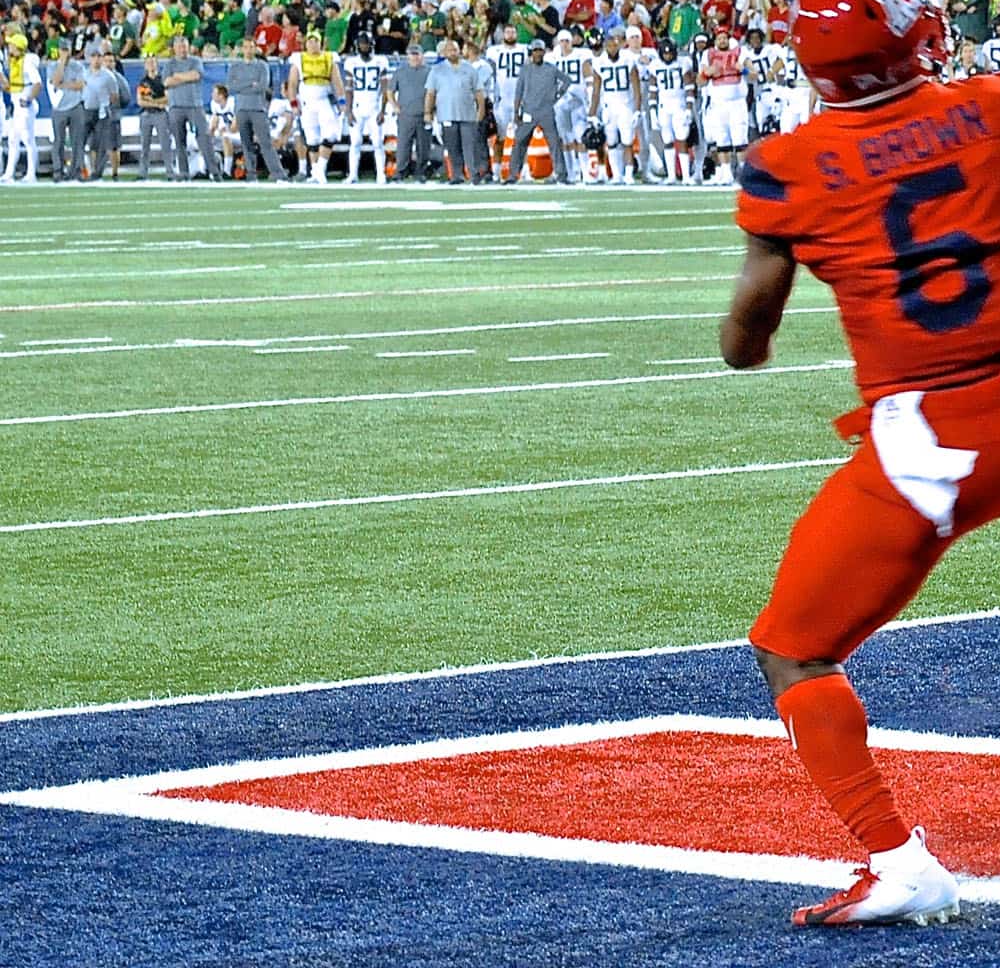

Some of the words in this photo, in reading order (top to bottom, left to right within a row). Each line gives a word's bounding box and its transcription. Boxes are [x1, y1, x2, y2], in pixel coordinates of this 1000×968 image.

[353, 66, 381, 91] 93
[498, 52, 526, 78] 48
[600, 64, 630, 92] 20
[857, 100, 989, 177] BROWN
[882, 163, 993, 333] 6
